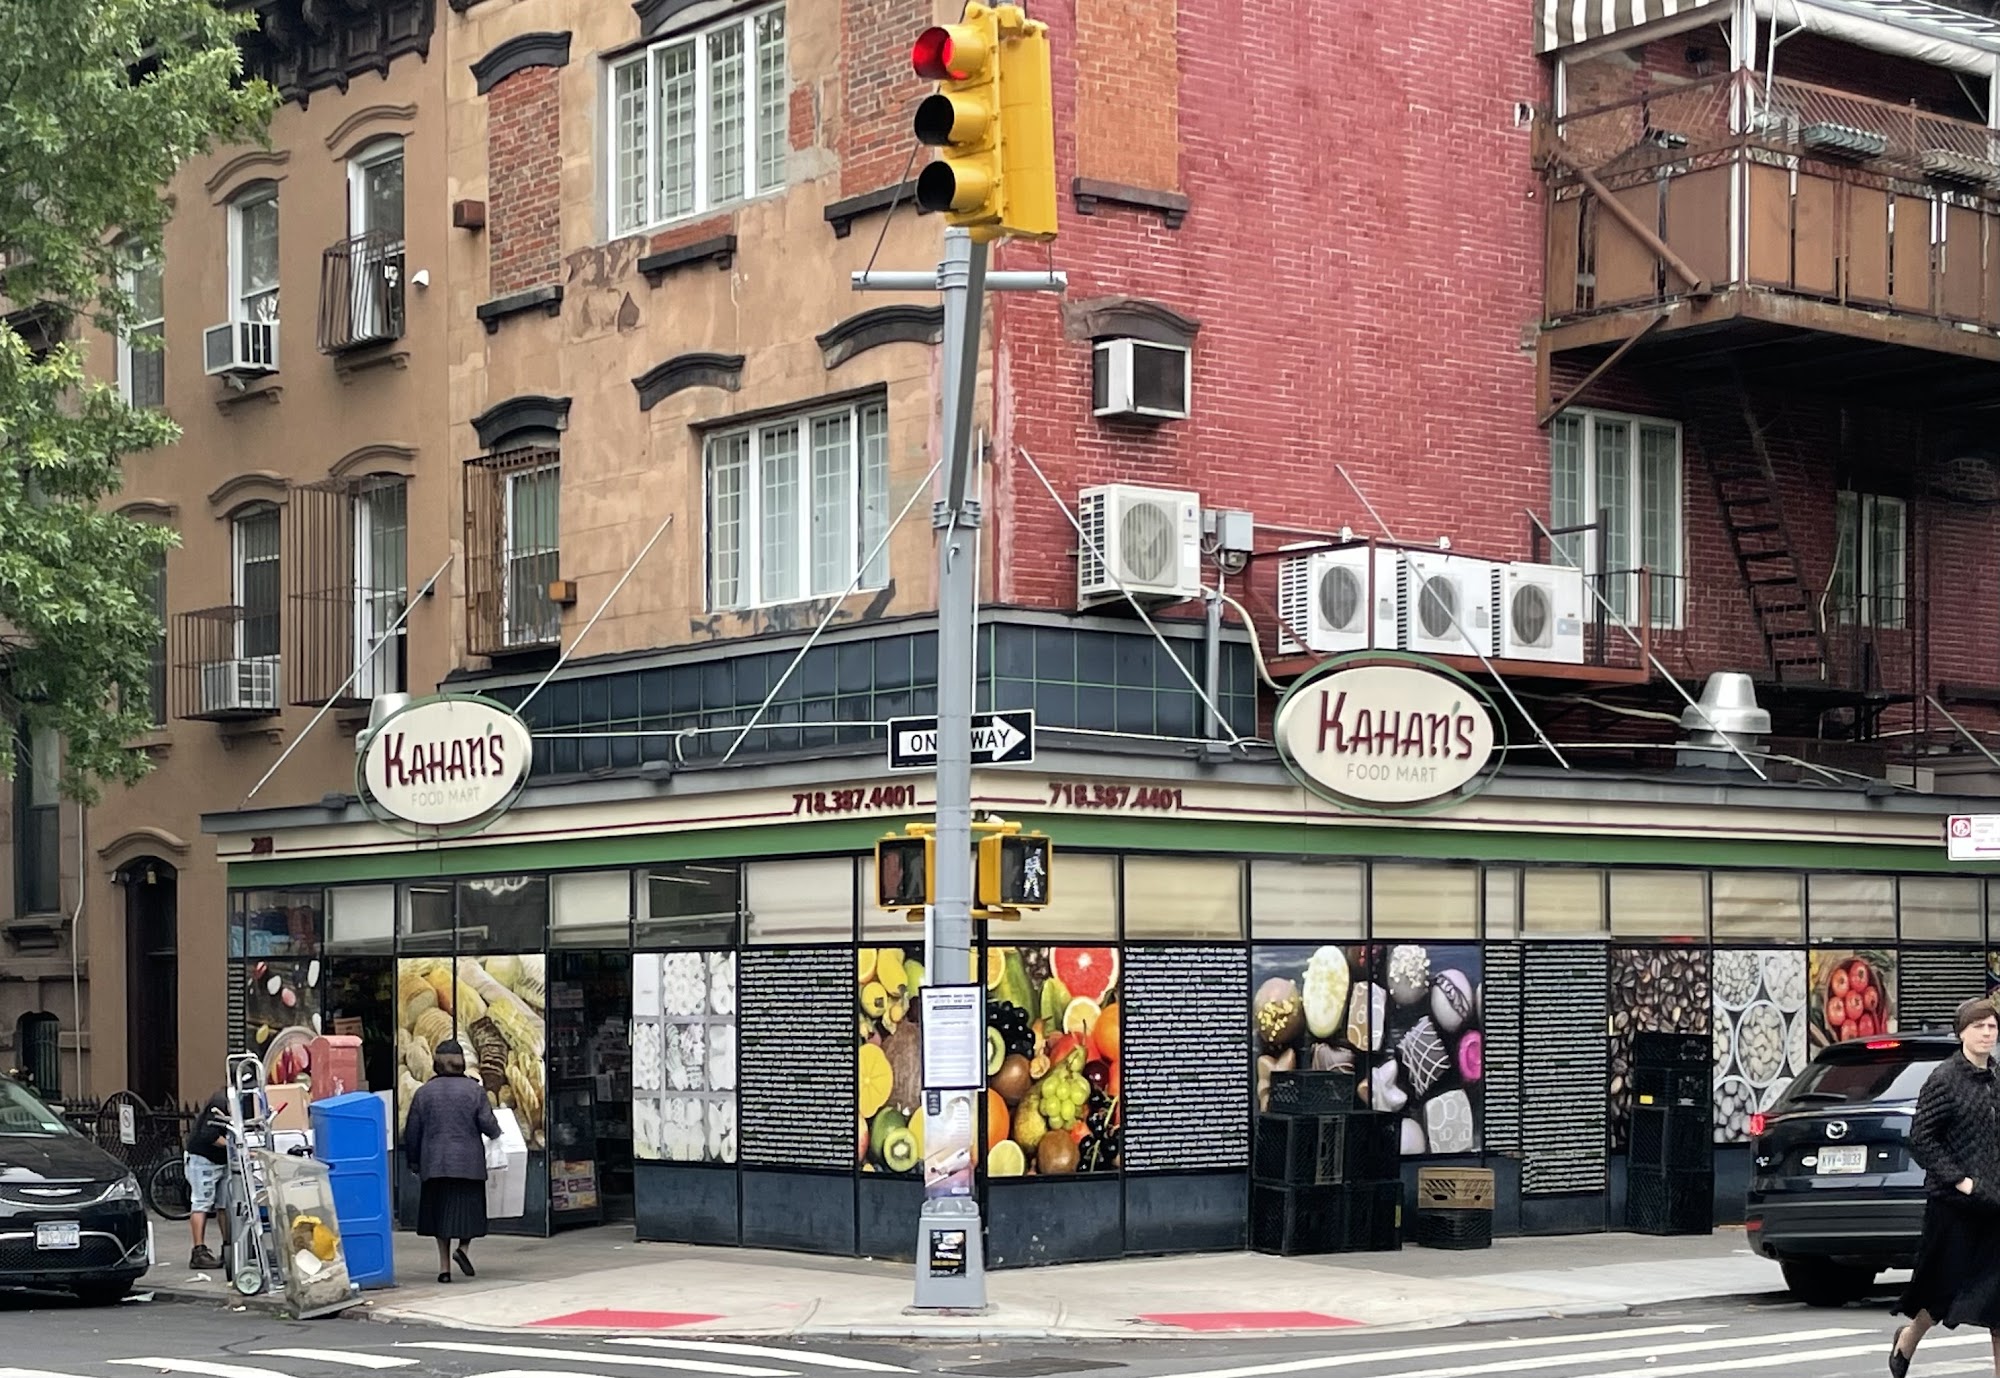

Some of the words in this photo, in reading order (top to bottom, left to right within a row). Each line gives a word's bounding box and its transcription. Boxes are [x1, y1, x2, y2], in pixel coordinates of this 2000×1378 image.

[911, 733, 938, 753] ON
[971, 729, 1011, 749] WAY
[1346, 763, 1390, 781] FOOD
[1396, 765, 1437, 783] MART
[411, 789, 444, 807] FOOD
[448, 786, 481, 804] MART
[1049, 782, 1182, 812] 718.387.4401
